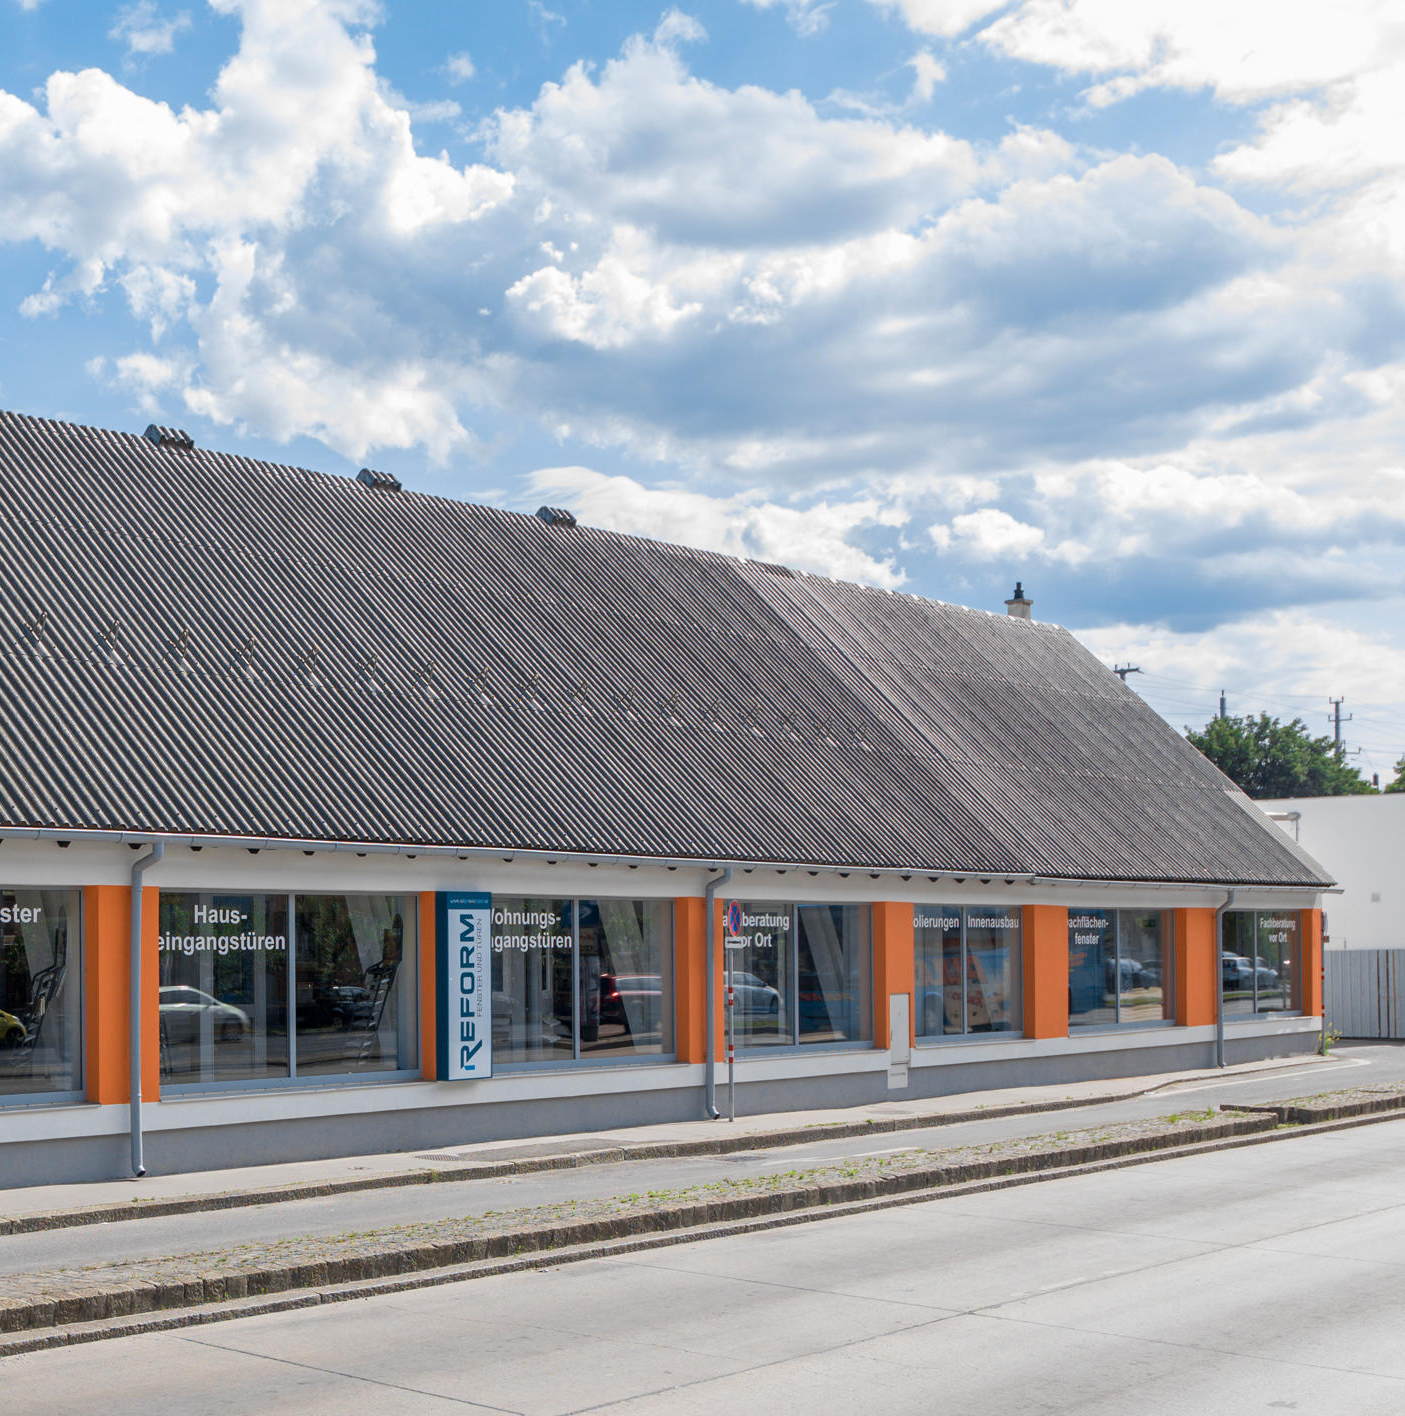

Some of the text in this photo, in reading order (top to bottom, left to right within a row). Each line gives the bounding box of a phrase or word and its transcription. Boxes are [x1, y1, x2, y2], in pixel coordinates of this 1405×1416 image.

[194, 904, 248, 925] Haus-
[491, 908, 561, 929] ohnungs-
[723, 912, 790, 931] aberatung
[967, 914, 1019, 929] Innenausbau
[1067, 915, 1110, 929] achflächen-
[913, 915, 960, 931] olierungen
[1259, 917, 1296, 931] Fachberatung
[158, 931, 286, 956] eingangstüren
[755, 932, 772, 948] Ort
[1074, 932, 1100, 945] fenster
[460, 914, 483, 1071] REFORM
